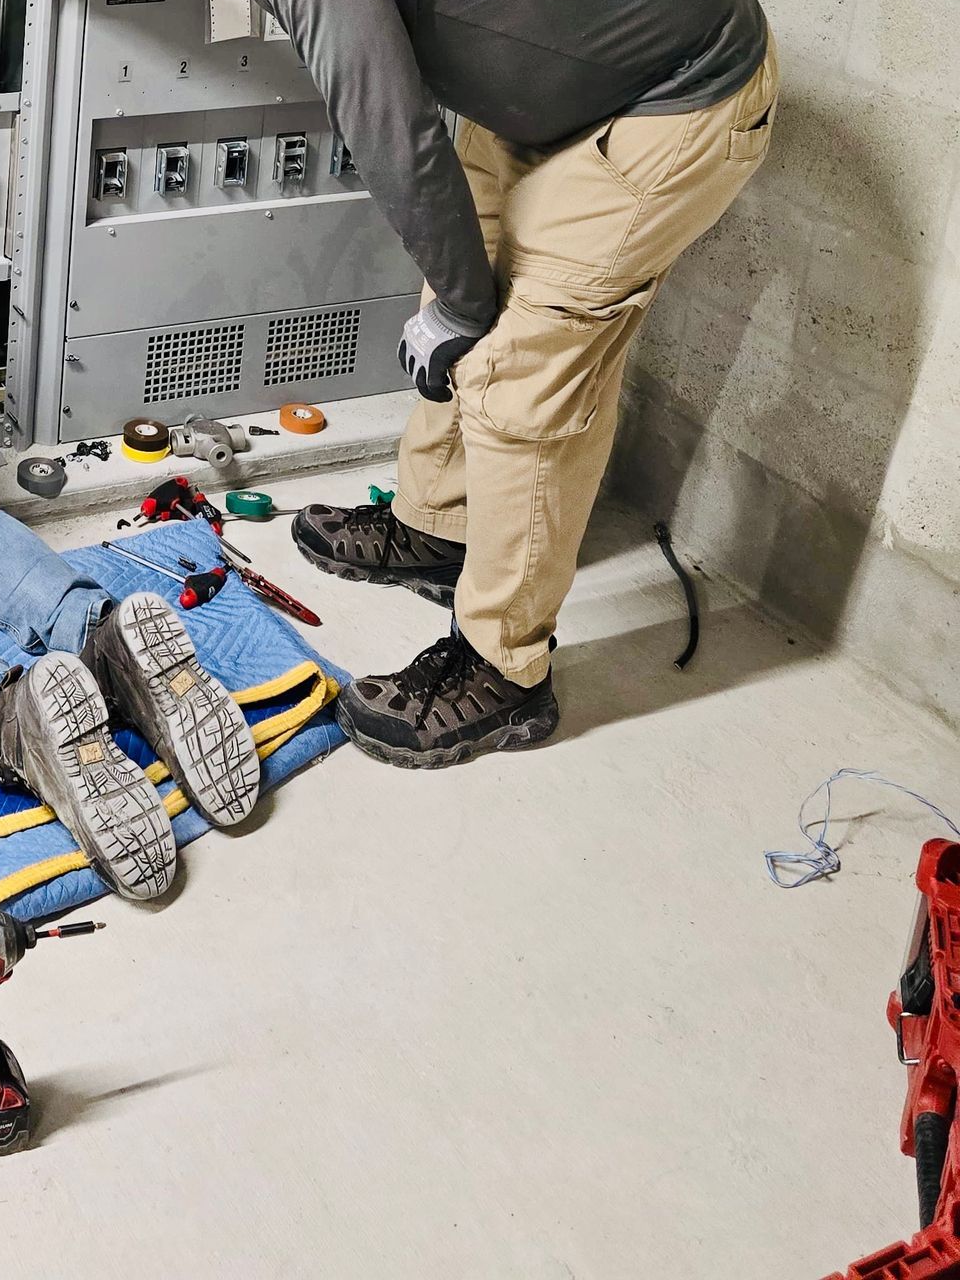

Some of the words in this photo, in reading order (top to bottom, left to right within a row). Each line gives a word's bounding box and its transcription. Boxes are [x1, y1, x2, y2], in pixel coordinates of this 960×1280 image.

[180, 60, 188, 74] 2
[240, 54, 248, 68] 3
[122, 64, 129, 78] 1
